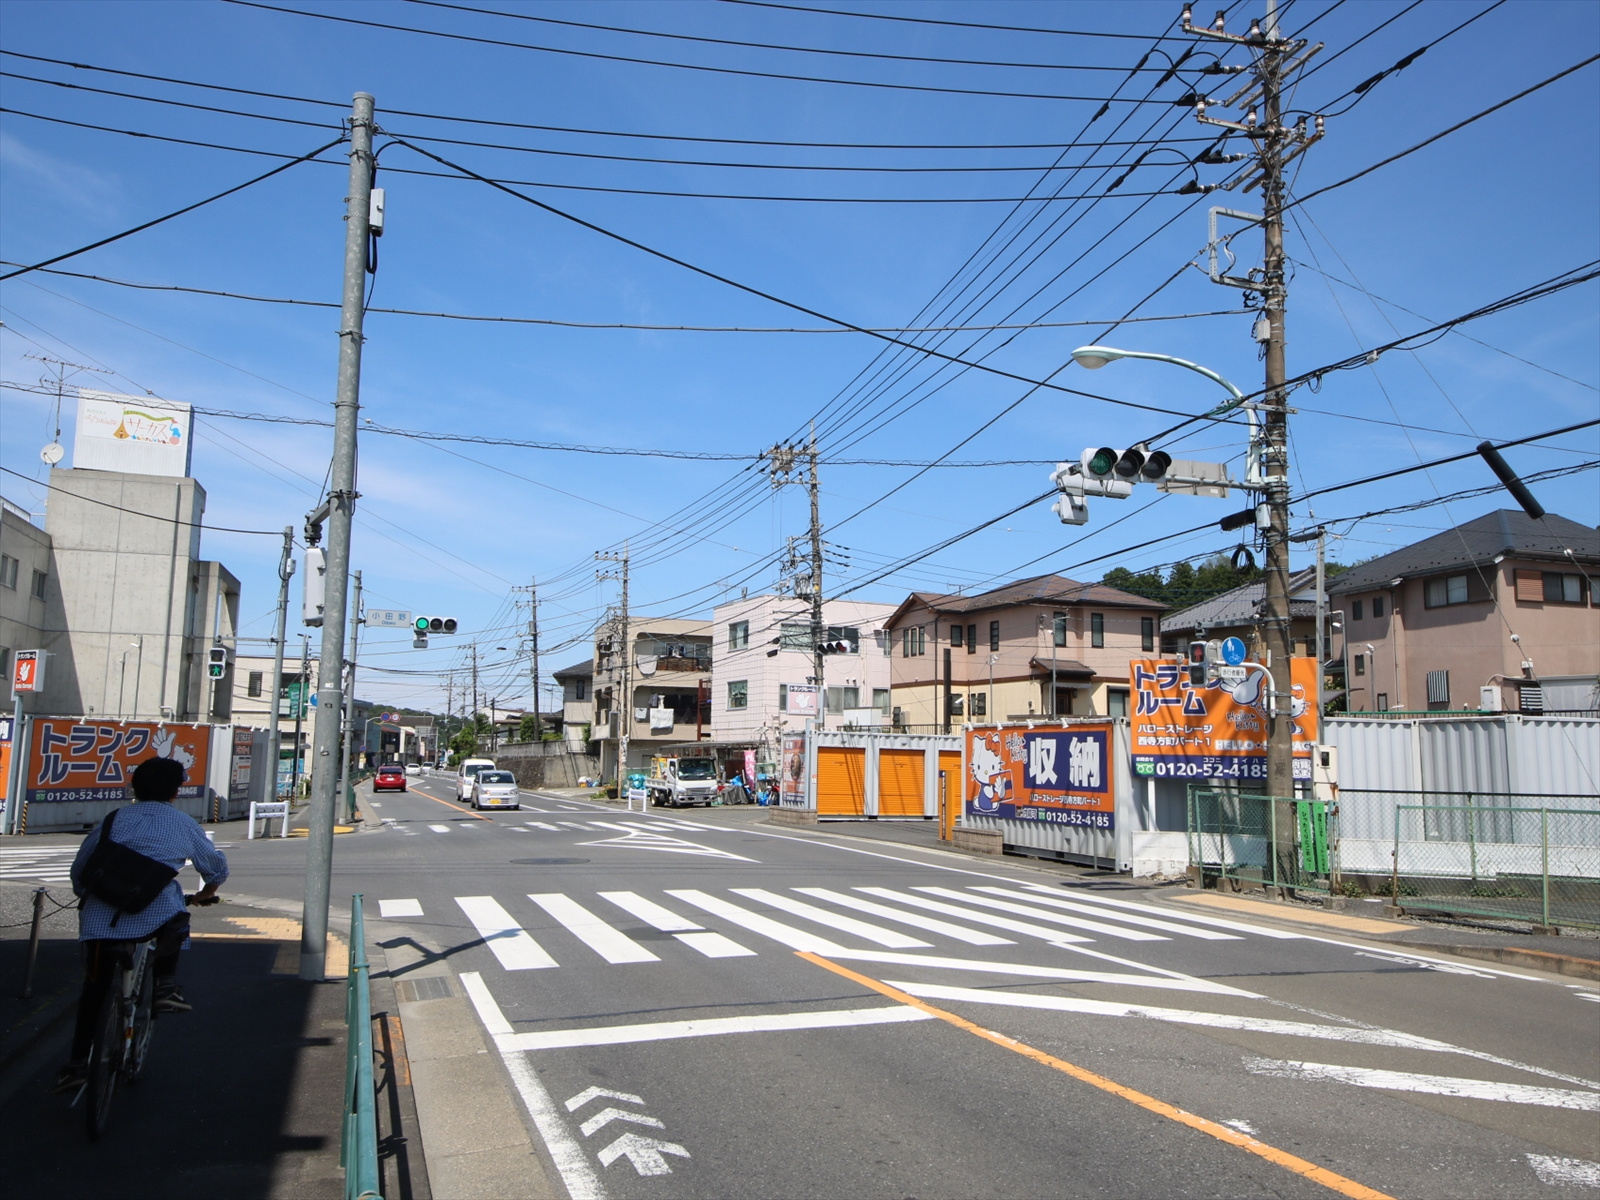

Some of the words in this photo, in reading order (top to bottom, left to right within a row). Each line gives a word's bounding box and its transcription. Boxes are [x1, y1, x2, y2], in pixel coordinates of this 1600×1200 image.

[372, 612, 407, 621] 小田野
[1135, 665, 1222, 690] トラ
[1136, 690, 1208, 716] ルーム
[1226, 710, 1251, 721] Hello
[1138, 724, 1213, 734] ハローストレージ
[1235, 721, 1260, 732] Kitty
[41, 723, 150, 756] トランク
[1214, 740, 1254, 751] HELLO
[1029, 736, 1100, 788] 収納
[37, 754, 124, 785] ルーム
[47, 790, 123, 800] 0120-52-4185
[1046, 811, 1109, 827] 0120-52-4185
